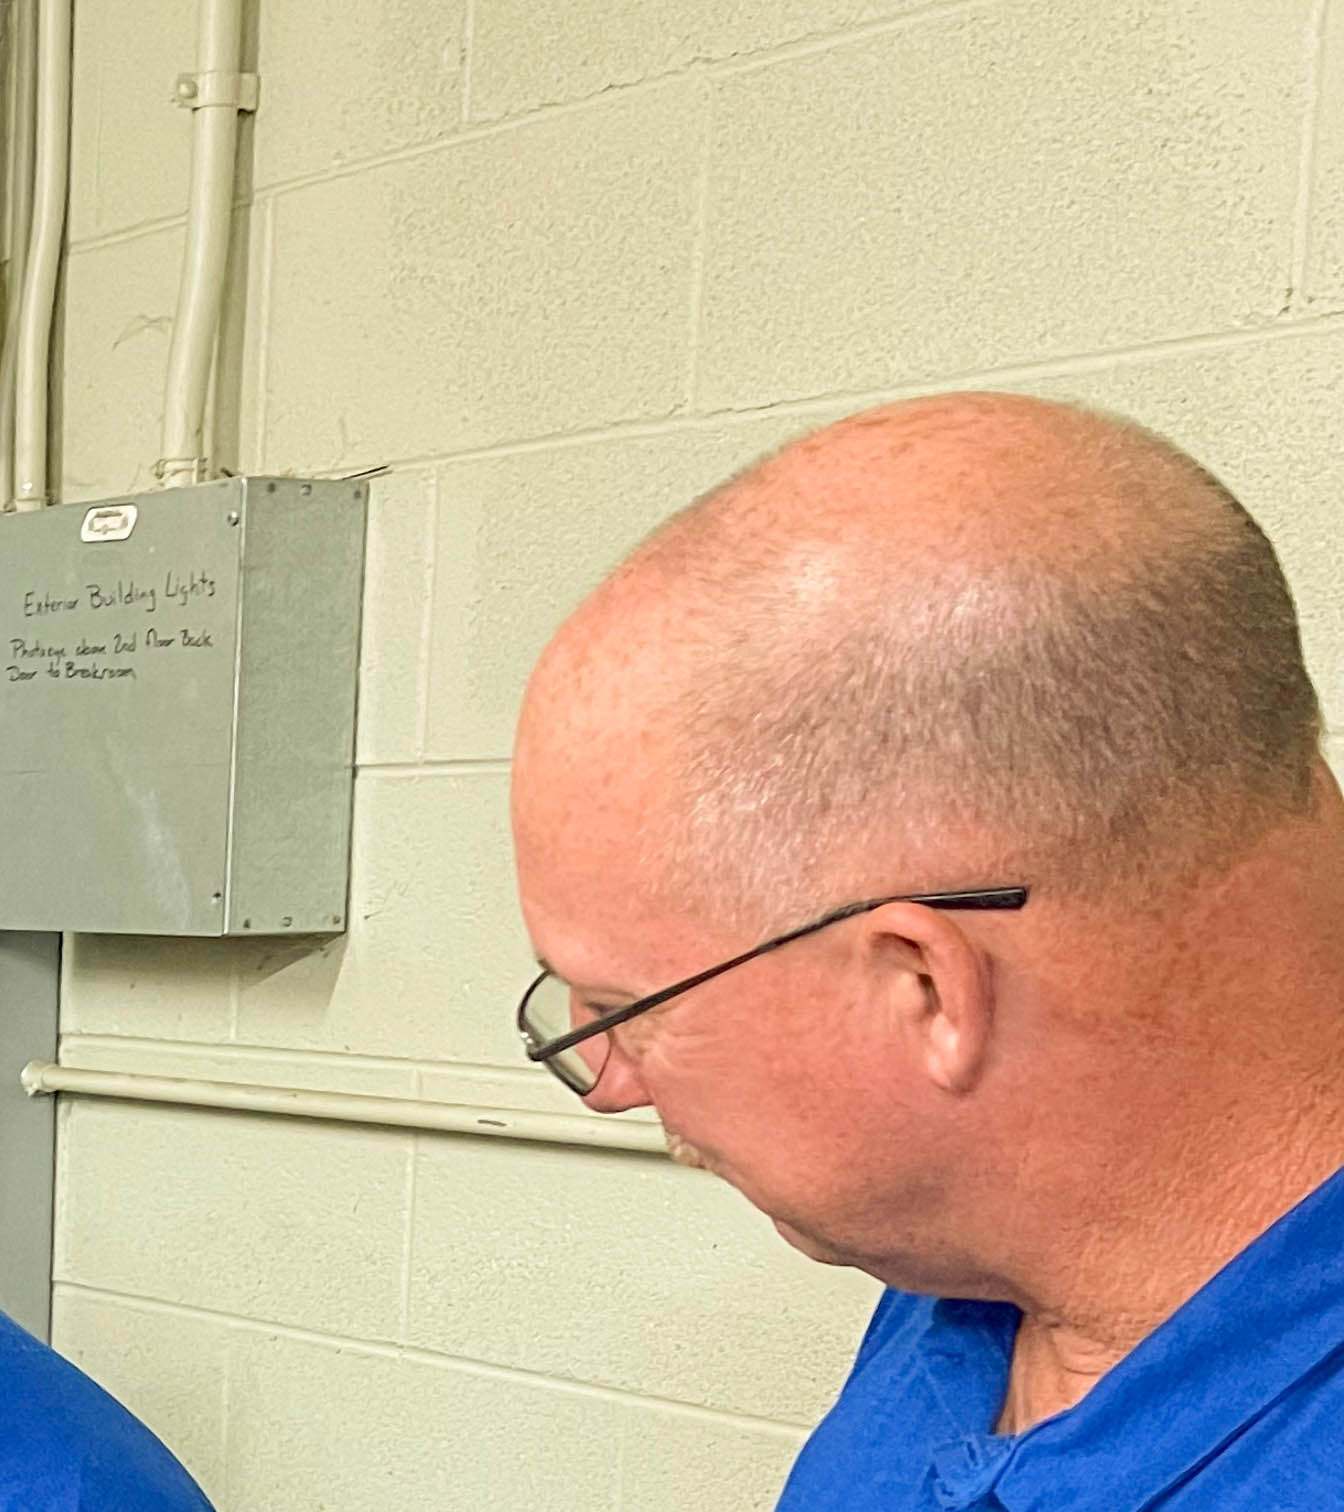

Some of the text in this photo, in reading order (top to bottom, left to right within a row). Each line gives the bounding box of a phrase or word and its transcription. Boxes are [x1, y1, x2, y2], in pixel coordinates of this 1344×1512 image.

[23, 570, 216, 616] Exterior Building Lights
[46, 662, 61, 678] to
